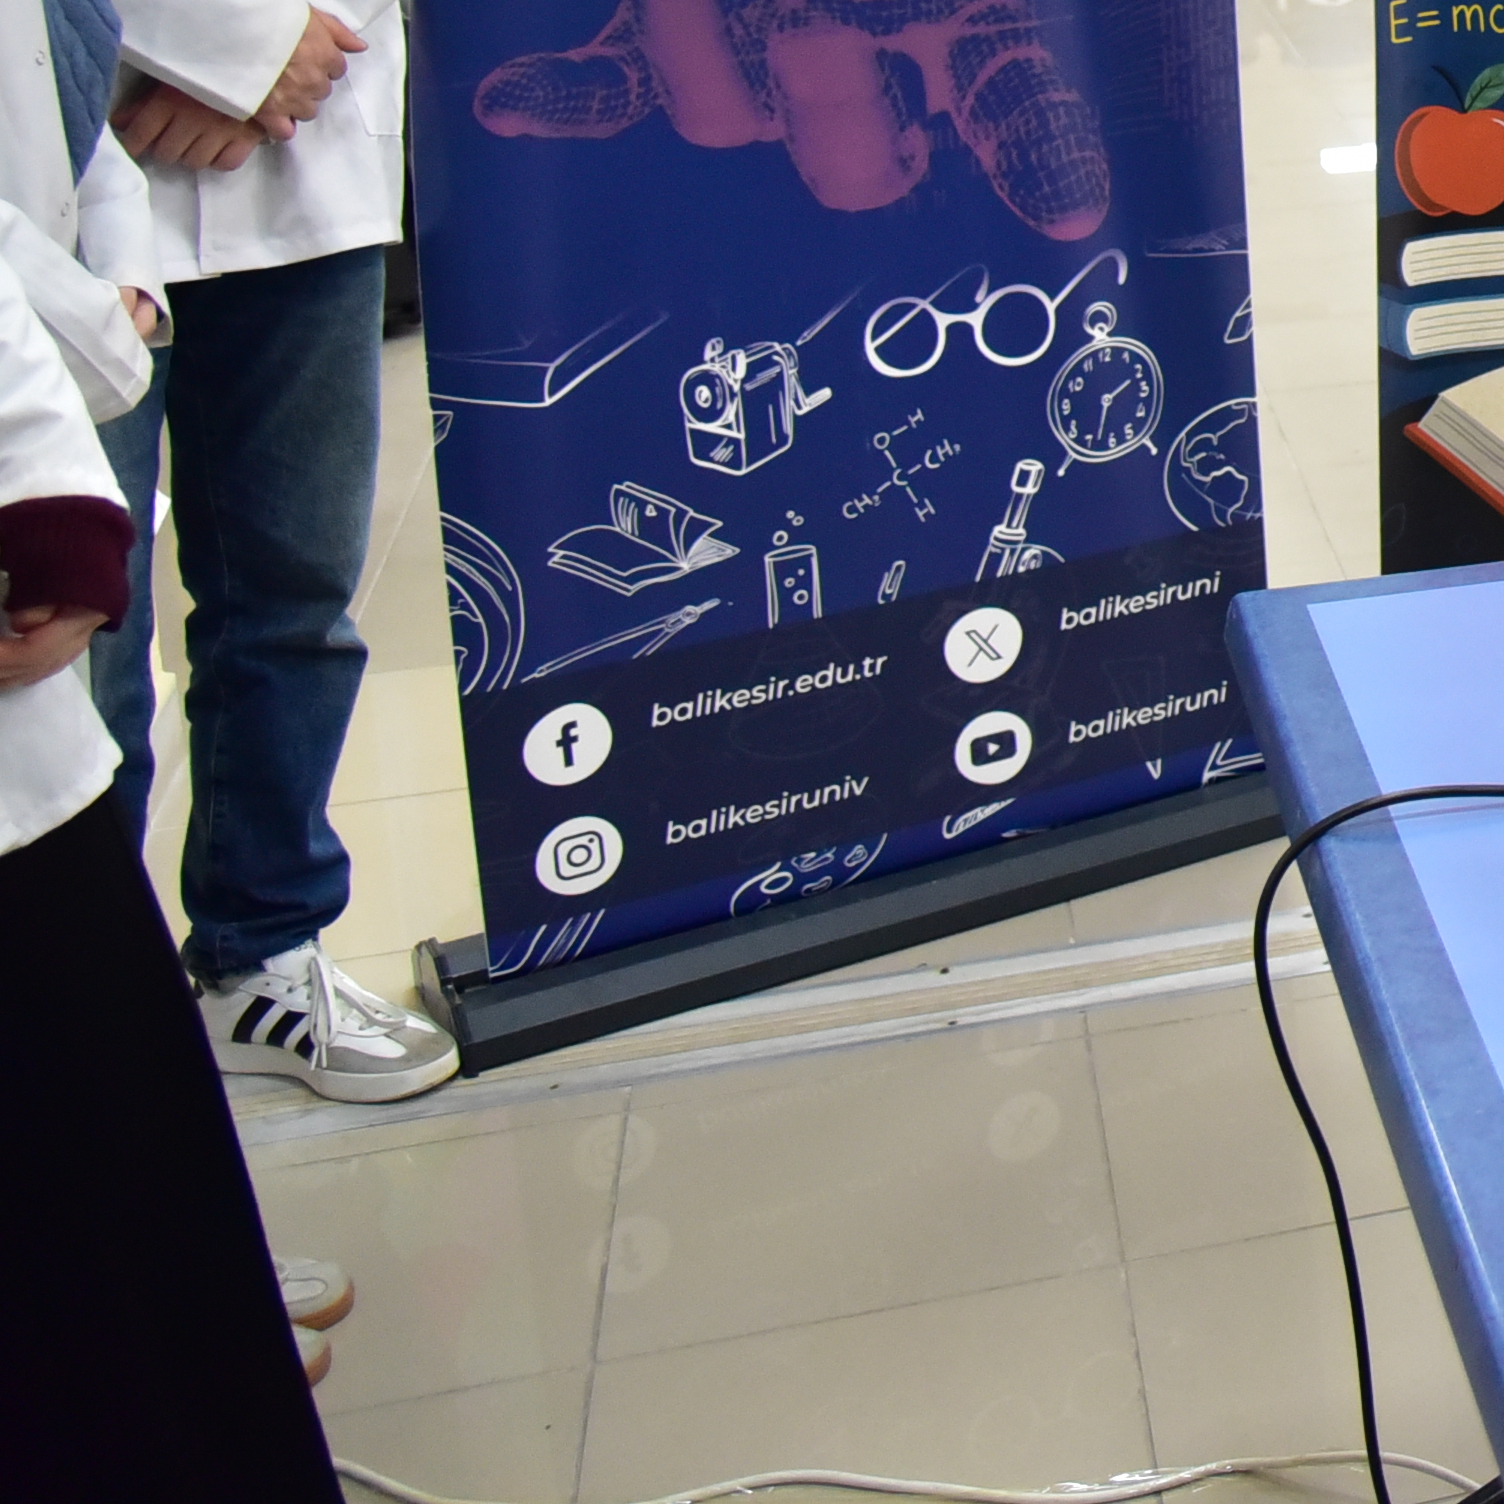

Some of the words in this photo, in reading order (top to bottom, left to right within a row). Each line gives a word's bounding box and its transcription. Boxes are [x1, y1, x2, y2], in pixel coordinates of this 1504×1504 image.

[1059, 570, 1221, 632] balikesiruni
[650, 652, 888, 729] balikesir.edu.tr
[1067, 680, 1228, 745] balikesiruni
[665, 772, 869, 846] balikesiruniv
